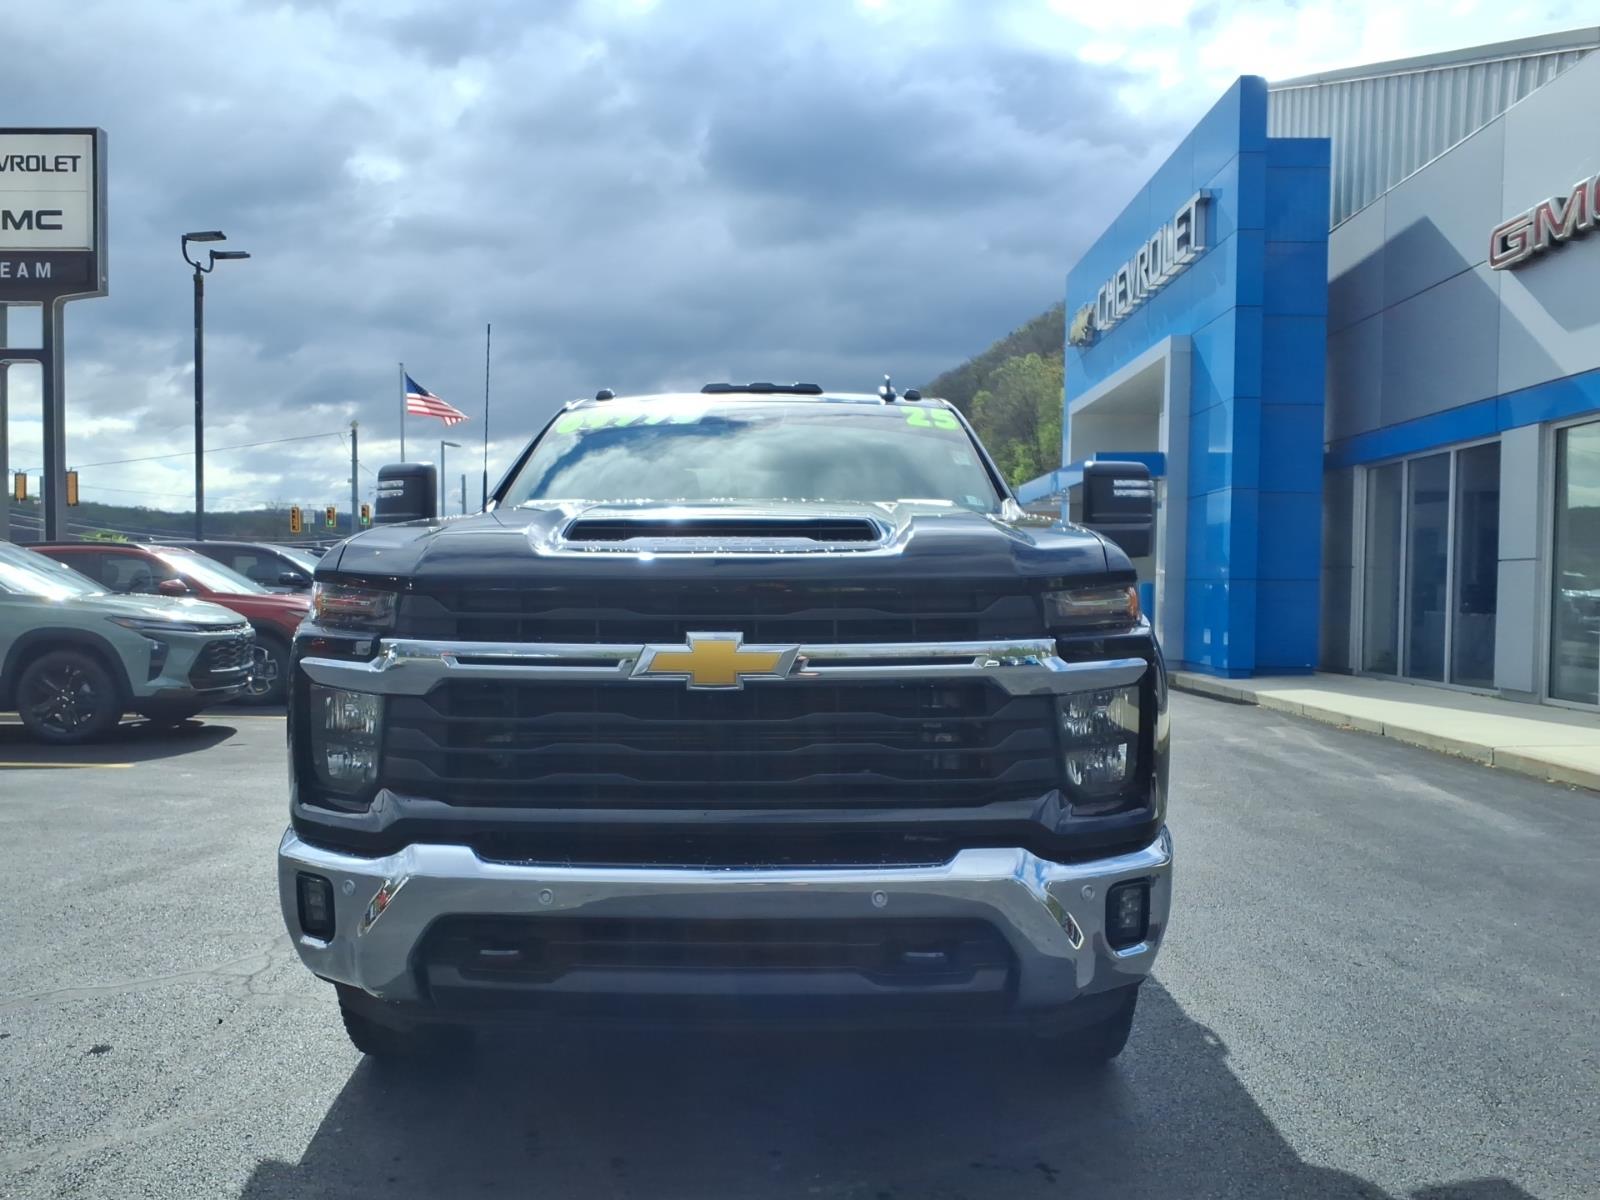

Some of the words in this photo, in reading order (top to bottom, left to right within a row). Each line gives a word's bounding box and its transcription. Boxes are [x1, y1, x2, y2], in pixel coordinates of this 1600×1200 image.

[2, 210, 63, 230] MC
[1488, 170, 1600, 270] GM
[0, 262, 51, 278] EAM
[1096, 189, 1211, 331] CHEVROLET
[900, 406, 958, 430] 25
